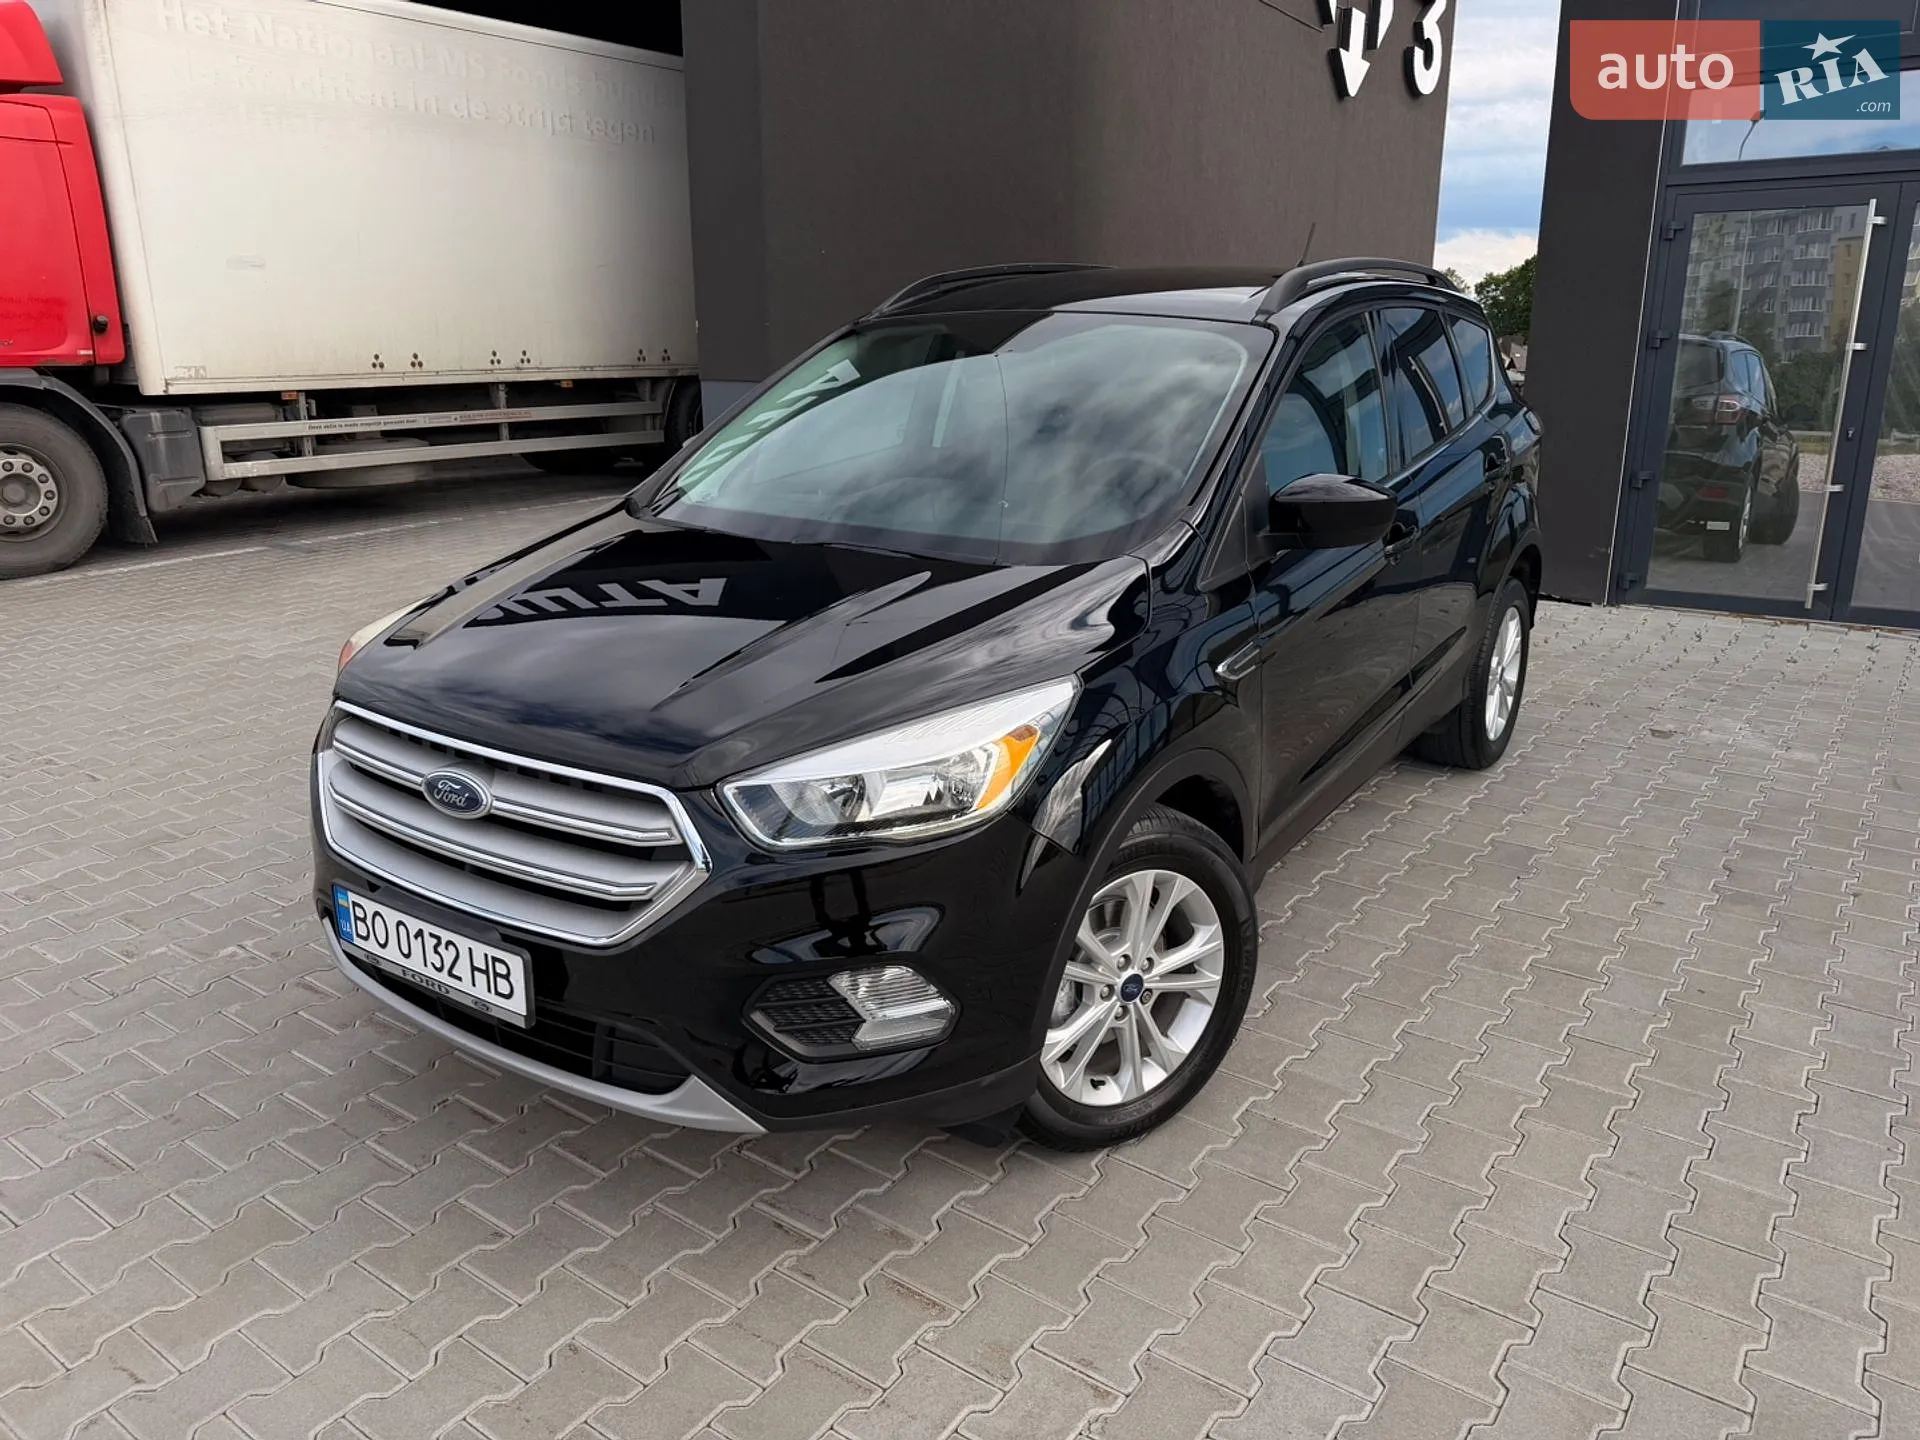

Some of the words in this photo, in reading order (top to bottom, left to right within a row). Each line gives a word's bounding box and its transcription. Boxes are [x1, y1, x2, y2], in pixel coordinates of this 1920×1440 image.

[159, 0, 232, 39] Het
[246, 13, 425, 72] Nationaal
[436, 45, 487, 79] MS
[495, 55, 583, 96] Fonds
[1411, 0, 1446, 94] 3
[408, 80, 441, 115] in
[452, 88, 490, 120] de
[498, 101, 575, 138] strijd
[584, 110, 656, 144] tegen
[433, 779, 470, 807] Ford
[340, 920, 351, 933] UA
[351, 899, 390, 950] BO
[395, 919, 463, 983] 0132
[468, 946, 515, 1000] HB
[401, 968, 450, 996] FORD
